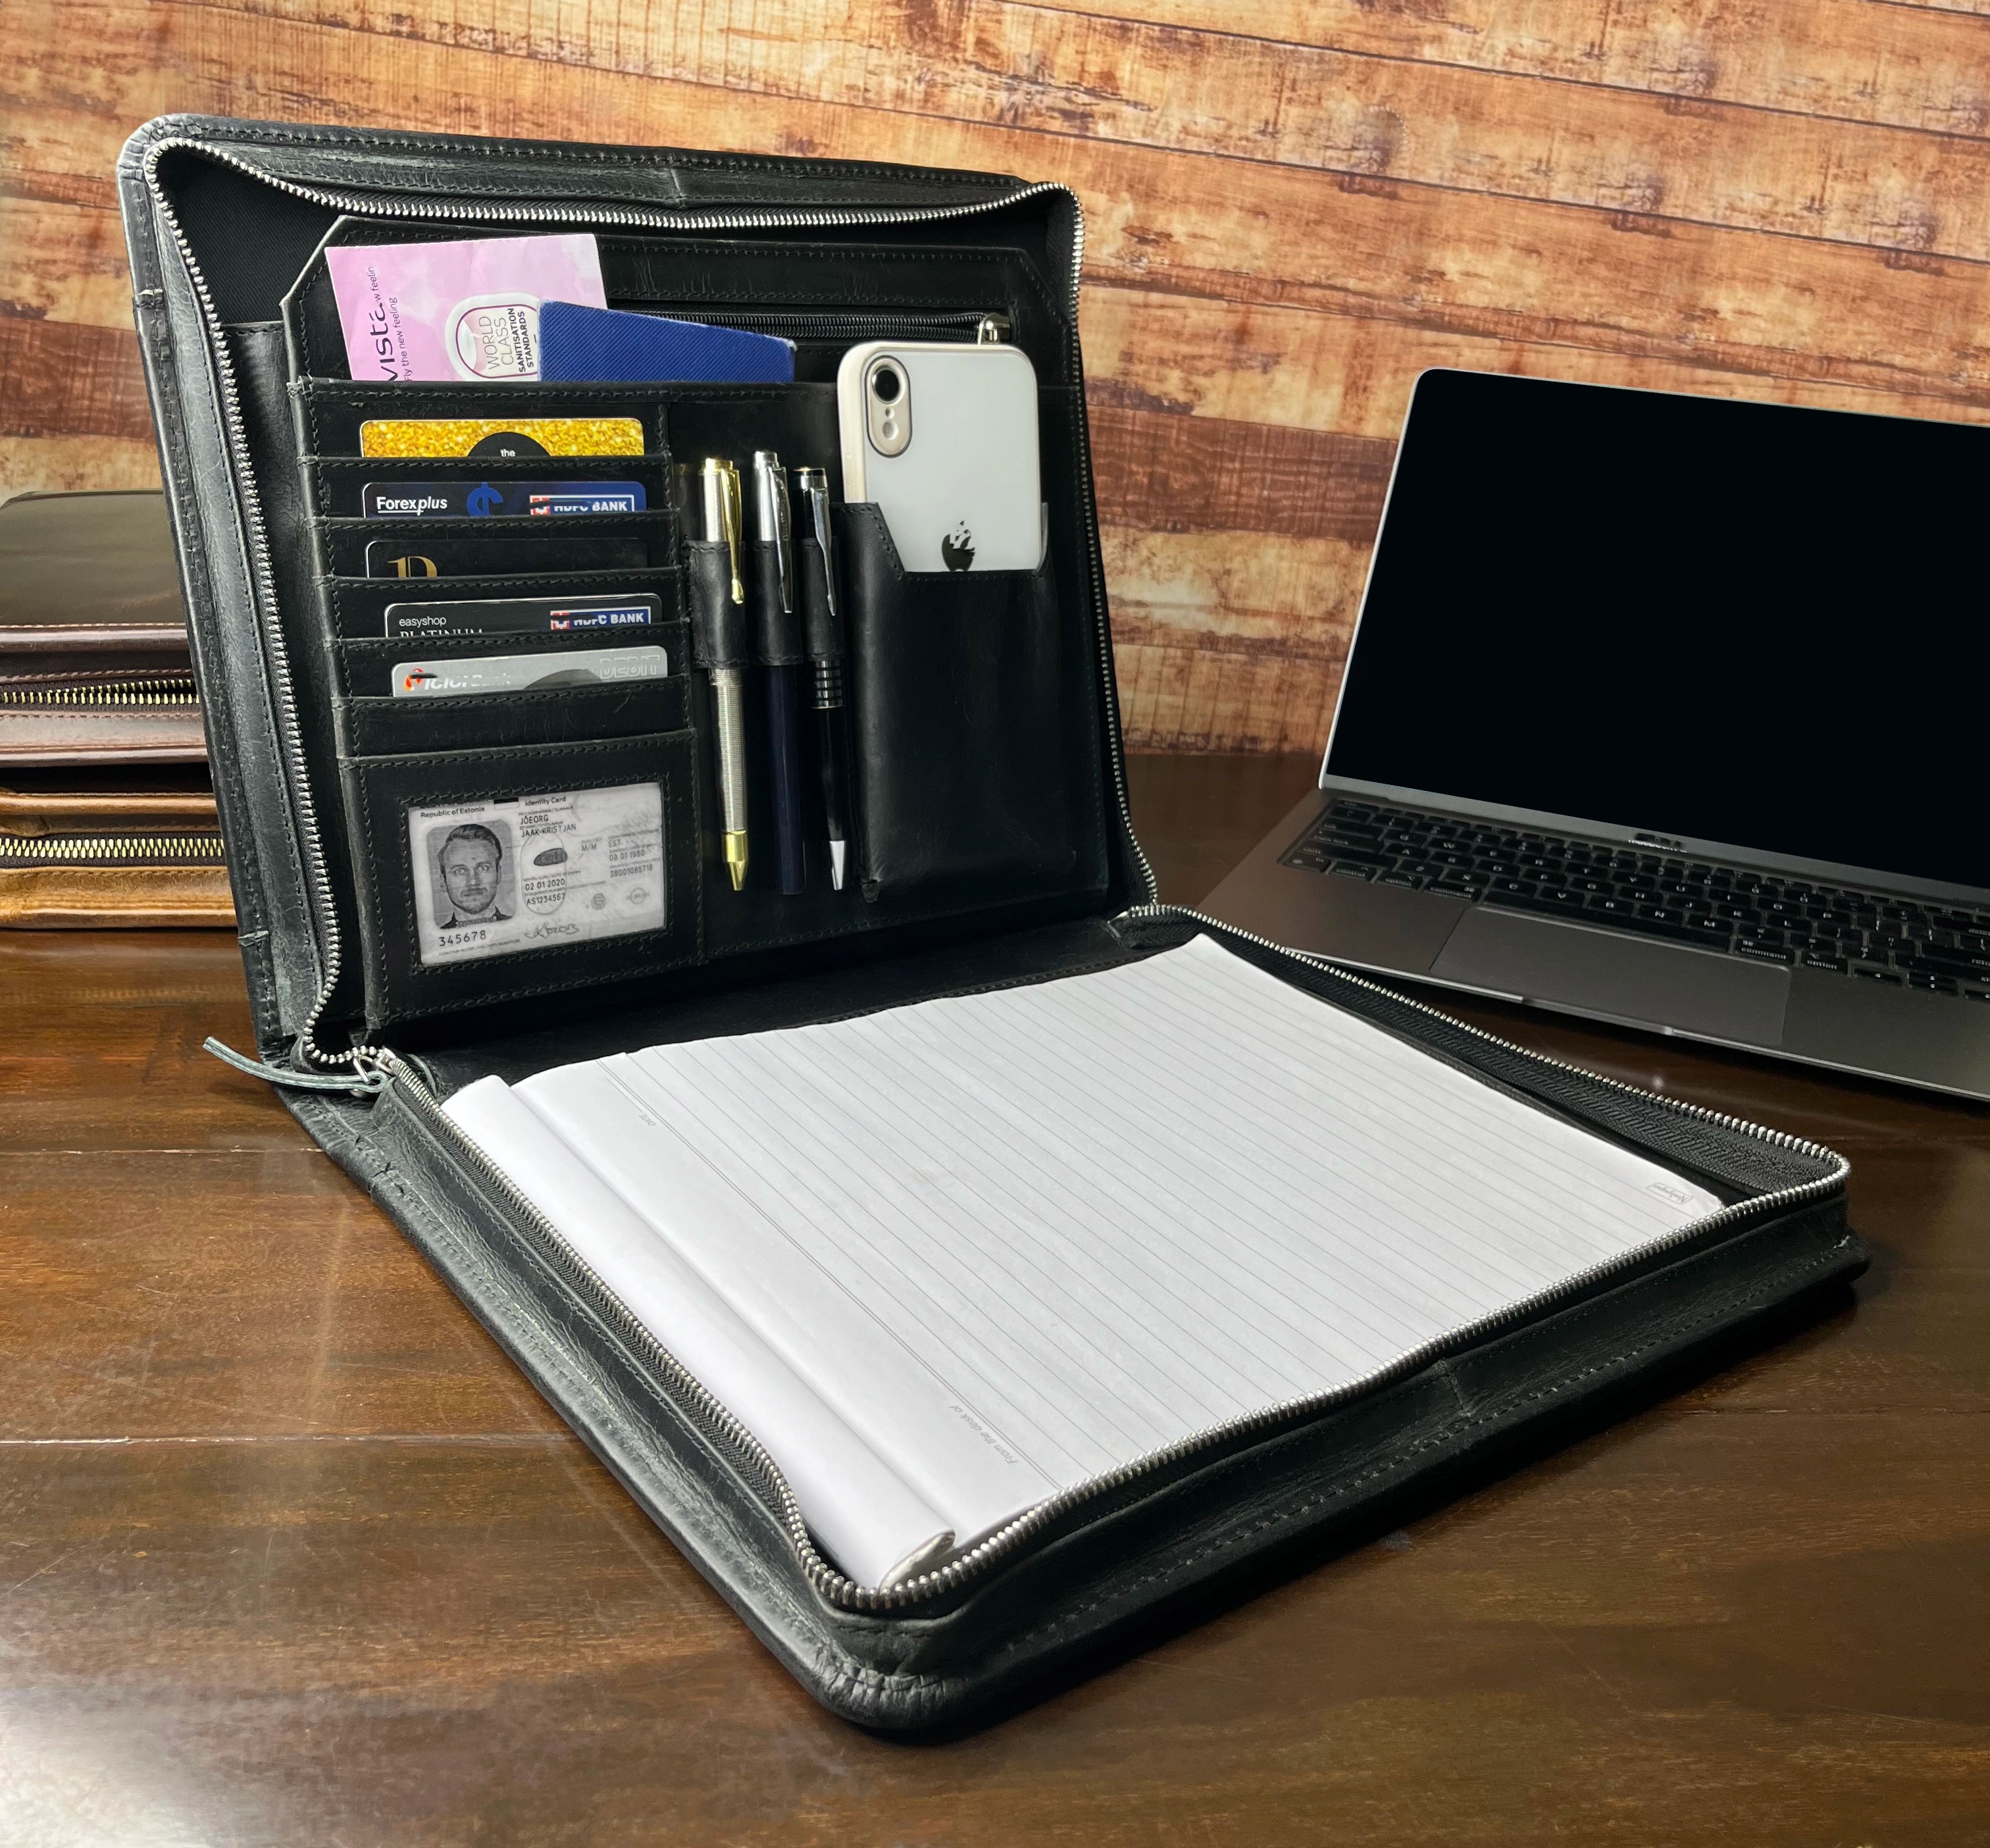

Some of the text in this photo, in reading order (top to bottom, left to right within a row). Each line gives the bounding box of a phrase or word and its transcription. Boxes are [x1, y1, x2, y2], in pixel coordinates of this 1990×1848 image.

[388, 297, 401, 328] feeling
[395, 330, 406, 349] new
[479, 316, 499, 370] WORLD
[494, 317, 514, 365] CLASS
[507, 308, 526, 373] SANITISATION
[518, 311, 534, 368] STANDARDS
[399, 351, 409, 367] the
[500, 448, 516, 457] the
[592, 501, 628, 511] BANK
[399, 616, 447, 628] easyshop
[610, 613, 645, 625] BANK
[525, 798, 550, 806] Identity
[421, 809, 451, 819] Republic
[608, 838, 621, 848] EST
[525, 883, 534, 891] 02
[547, 878, 565, 888] 2020
[526, 892, 566, 906] AS1234567
[438, 930, 487, 947] 345678
[994, 1445, 1019, 1464] From
